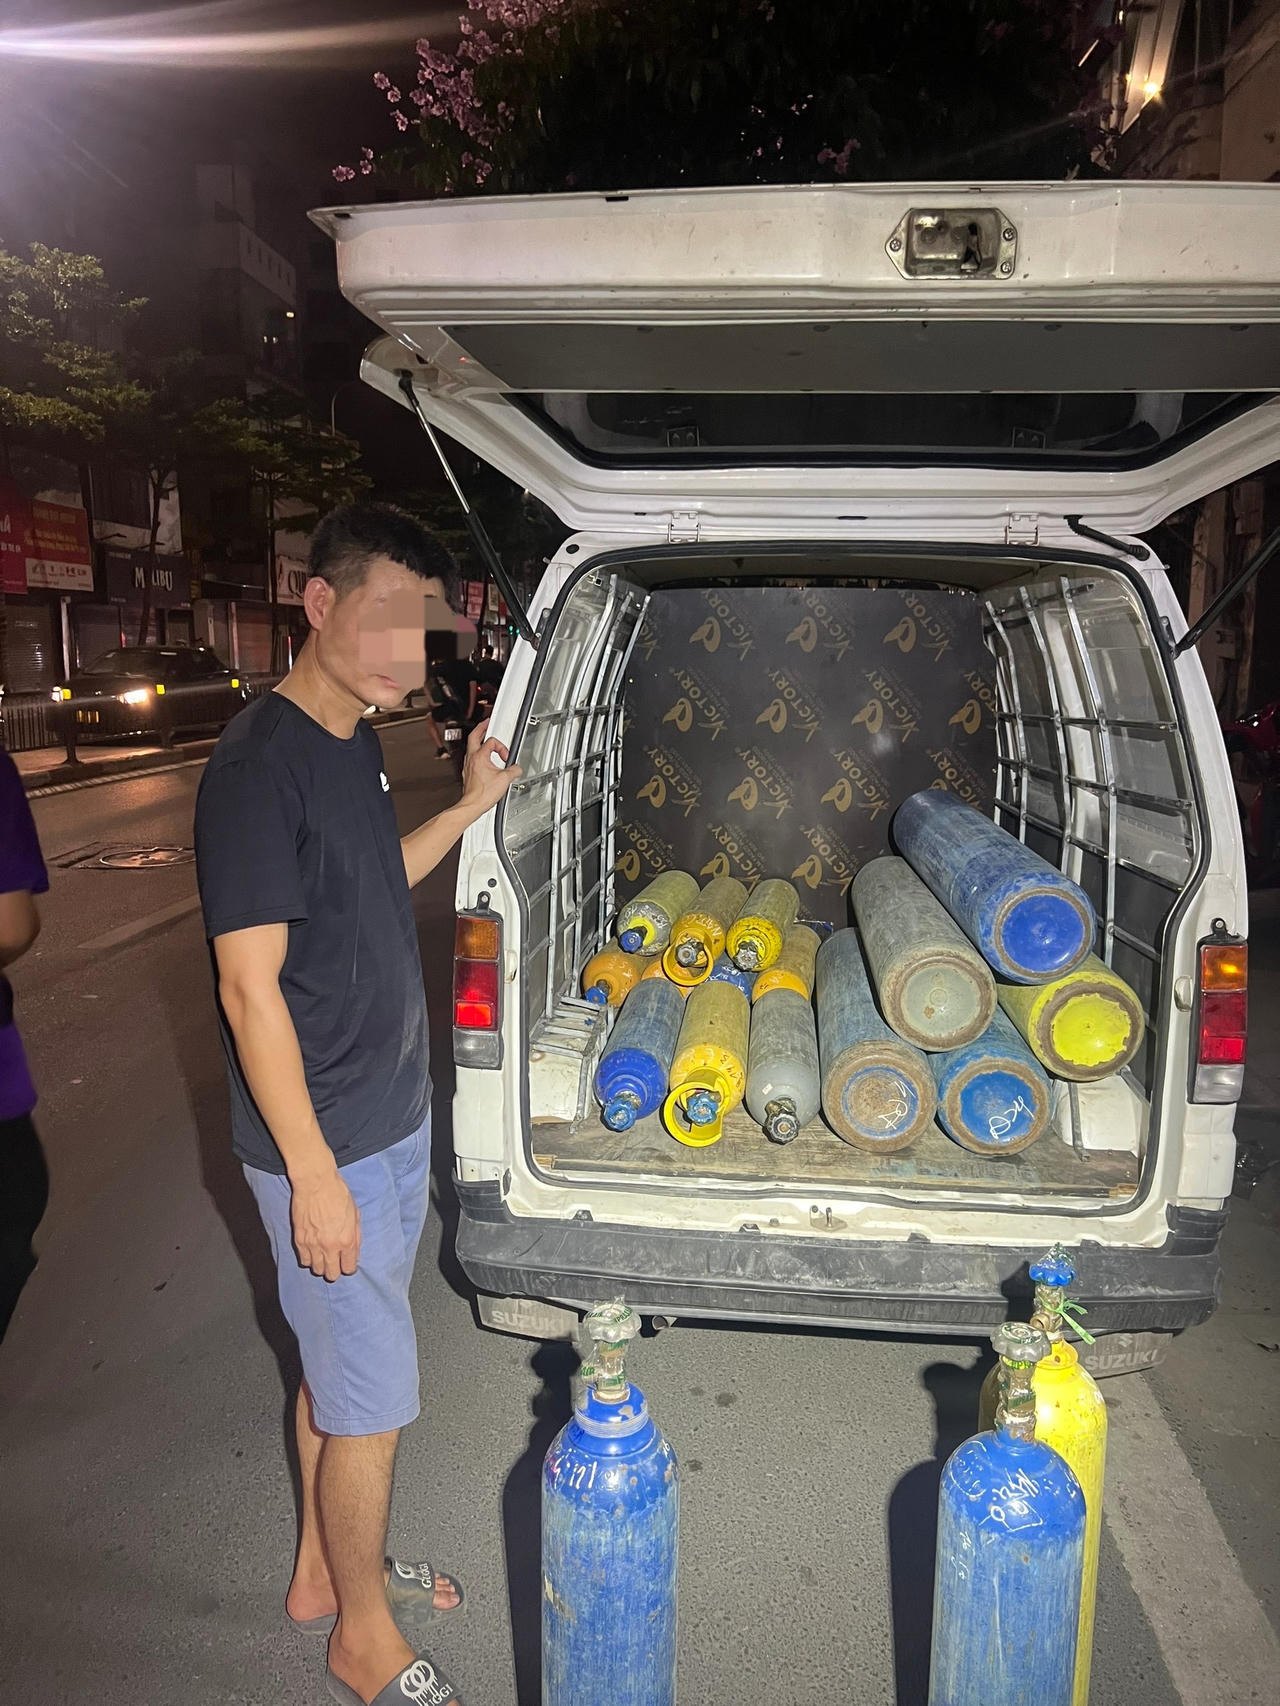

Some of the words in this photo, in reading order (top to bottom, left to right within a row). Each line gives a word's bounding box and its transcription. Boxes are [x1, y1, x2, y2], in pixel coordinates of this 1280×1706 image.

[135, 566, 173, 592] MLIBU
[700, 588, 756, 661] VICTORY
[797, 588, 854, 661] VICTORY
[897, 588, 953, 661] VICTORY
[673, 669, 728, 741] VICTORY
[769, 671, 822, 743] VICTORY
[865, 671, 920, 743] VICTORY
[648, 748, 700, 818] VICTORY
[739, 749, 793, 820] VICTORY
[833, 750, 890, 821] VICTORY
[622, 823, 667, 879] ICTORY
[711, 825, 763, 896] VICTORY
[802, 828, 853, 897] VICTORY
[491, 1310, 565, 1332] SUZUKI
[1083, 1349, 1158, 1371] SUZUKI
